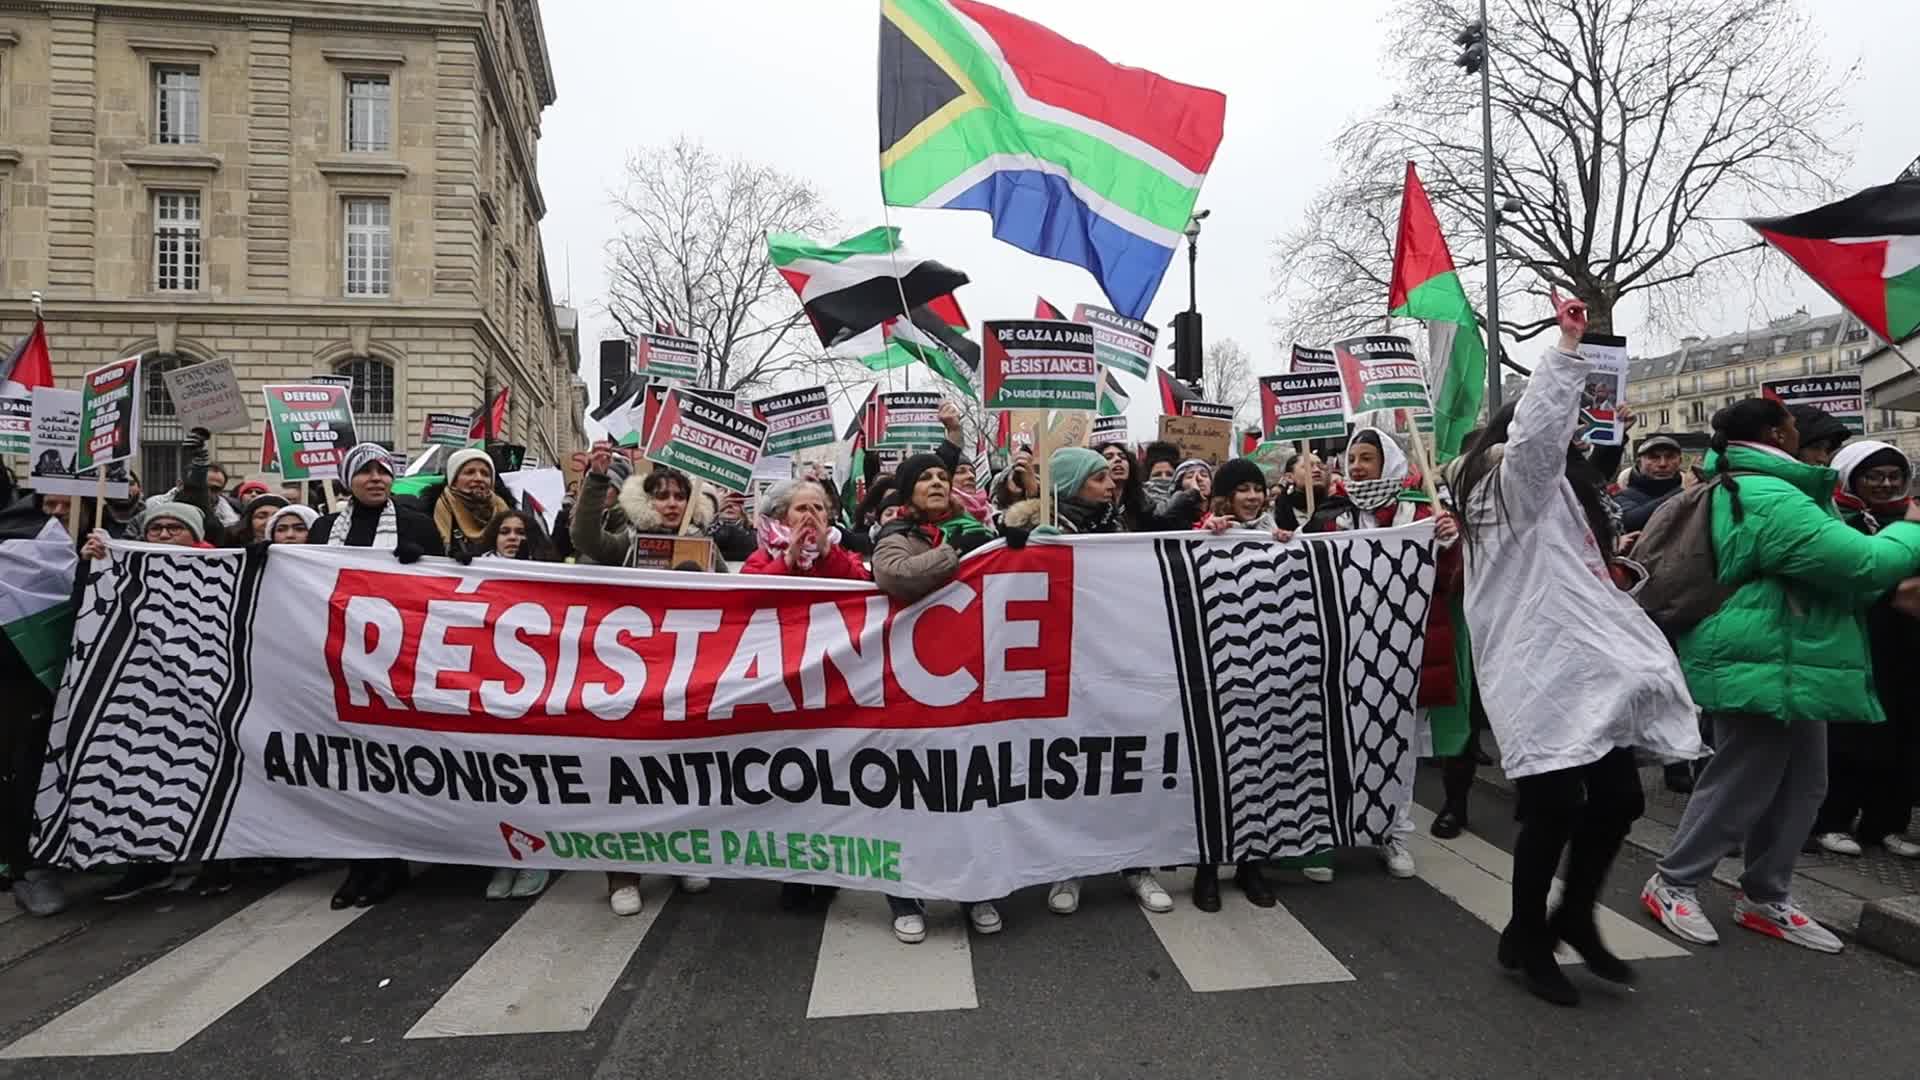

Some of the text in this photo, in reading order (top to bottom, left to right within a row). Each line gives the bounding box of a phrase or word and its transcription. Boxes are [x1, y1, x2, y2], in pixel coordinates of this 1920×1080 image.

[998, 329, 1094, 345] DE GAZA A PARIS
[1349, 344, 1364, 355] DE
[1365, 342, 1394, 352] GAZA
[1270, 377, 1340, 392] DE GAZA A PARIS
[1774, 386, 1790, 395] DE
[1791, 383, 1823, 394] GAZA
[1824, 382, 1833, 392] A
[283, 390, 330, 402] DEFEND
[894, 396, 917, 405] GAZA
[1012, 389, 1095, 401] URGENCE PALESTINE
[769, 398, 795, 411] GAZA
[280, 408, 343, 423] PALESTINE
[678, 399, 764, 440] DE GAZA A PARIS
[89, 433, 113, 452] GAZA
[292, 430, 339, 442] DEFEND
[300, 450, 336, 464] GAZA
[673, 450, 711, 472] URGENCE
[341, 572, 1050, 722] RÉSISTANCE
[264, 731, 592, 805] ANTISIONISTE
[608, 736, 1147, 813] ANTICOLONIALISTE
[545, 830, 901, 882] URGENCE PALESTINE
